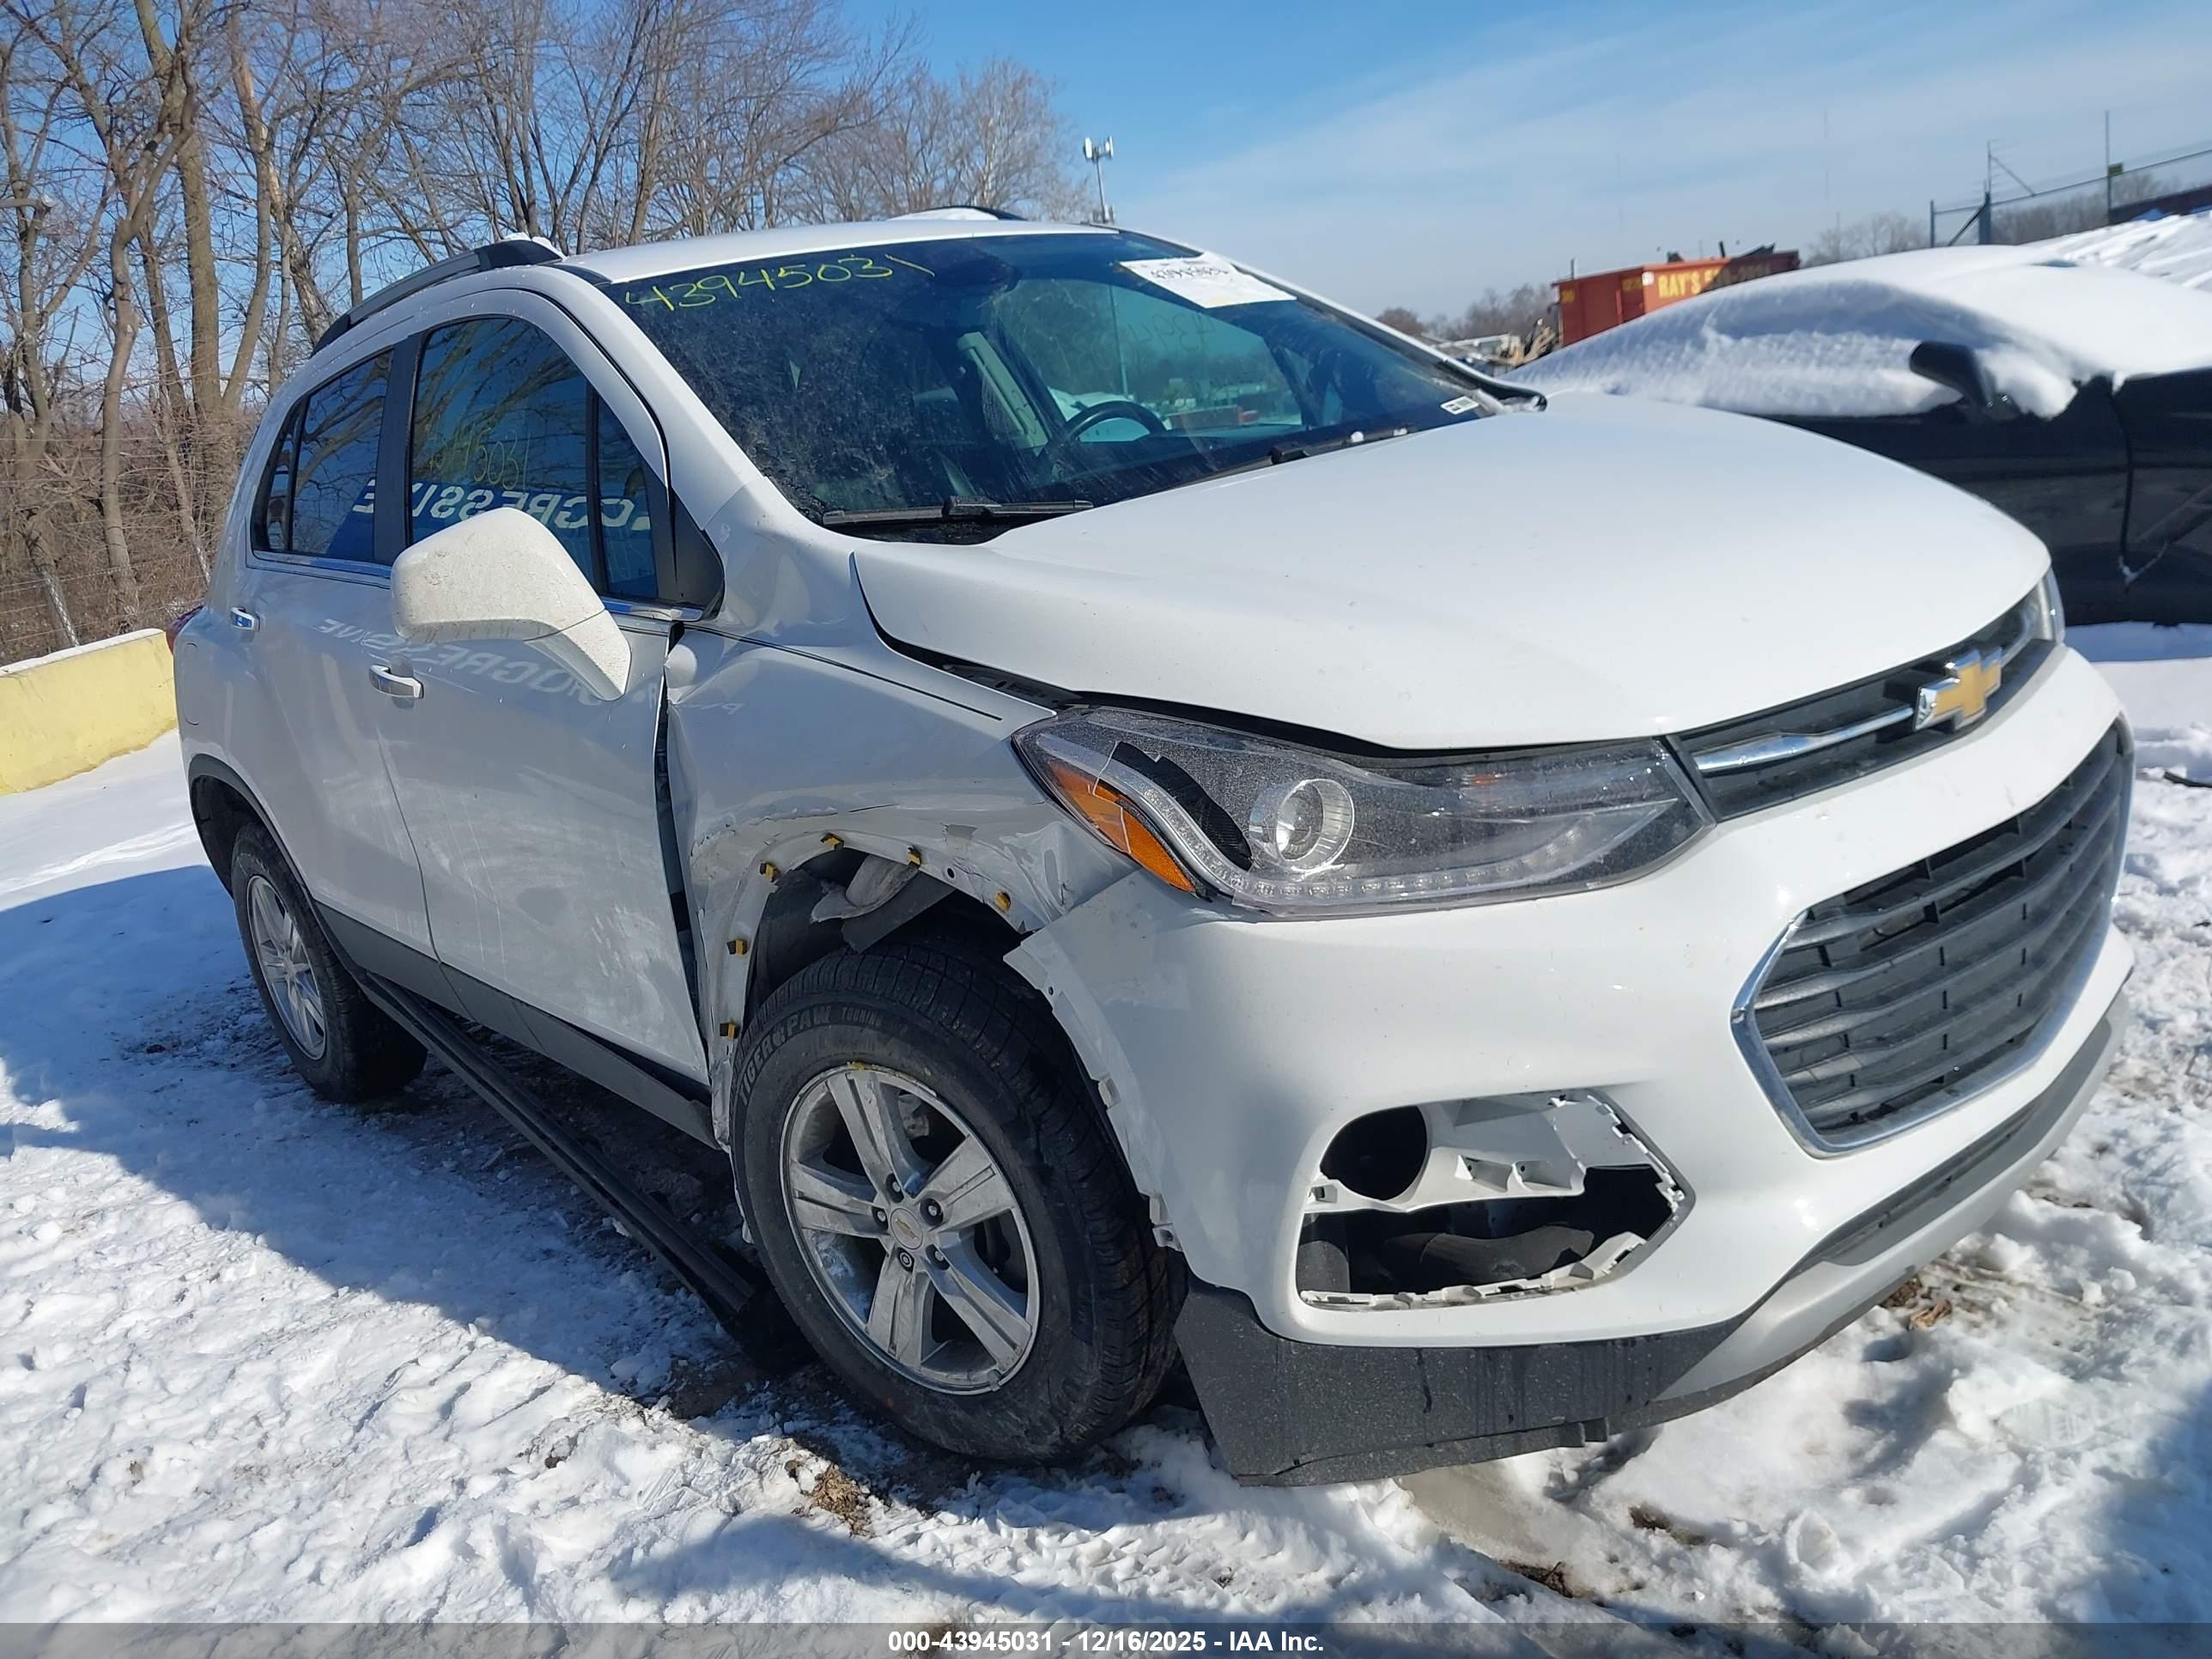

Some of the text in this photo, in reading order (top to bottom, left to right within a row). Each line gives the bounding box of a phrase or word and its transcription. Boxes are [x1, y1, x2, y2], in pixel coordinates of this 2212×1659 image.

[625, 254, 935, 311] 43945031
[1658, 270, 1700, 298] RAY'S
[739, 1034, 774, 1106] TIGER
[787, 1005, 831, 1036] PAW
